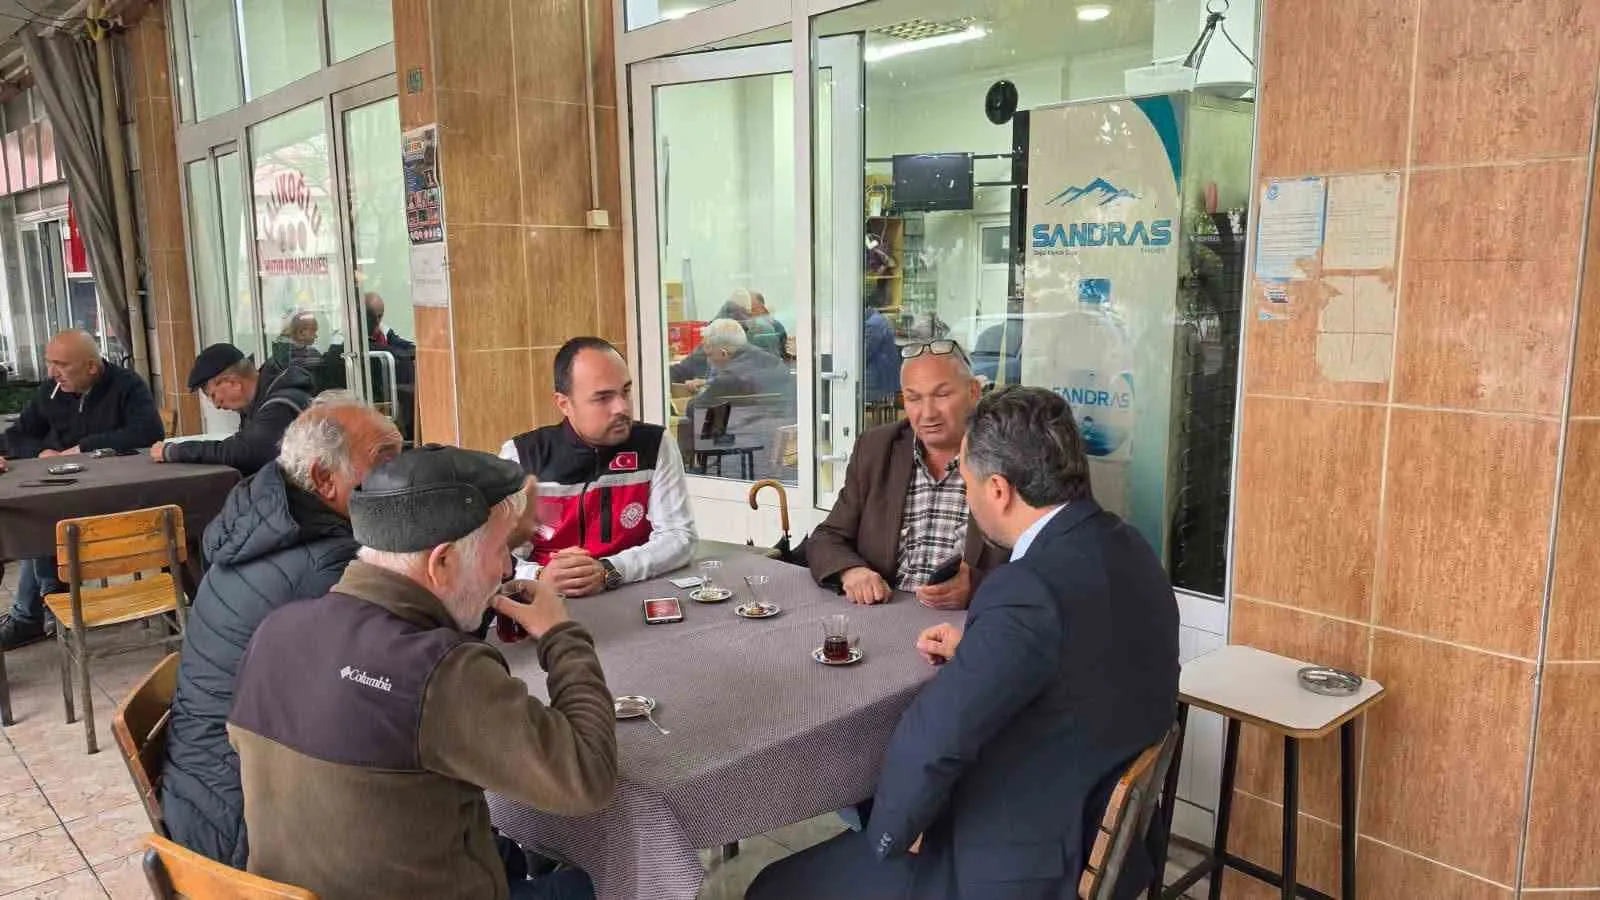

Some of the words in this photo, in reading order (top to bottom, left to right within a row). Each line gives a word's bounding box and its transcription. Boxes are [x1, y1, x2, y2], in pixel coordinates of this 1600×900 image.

[1032, 219, 1172, 248] SANDRAS
[1053, 386, 1130, 409] ANDRAS
[348, 668, 392, 692] Columbia
